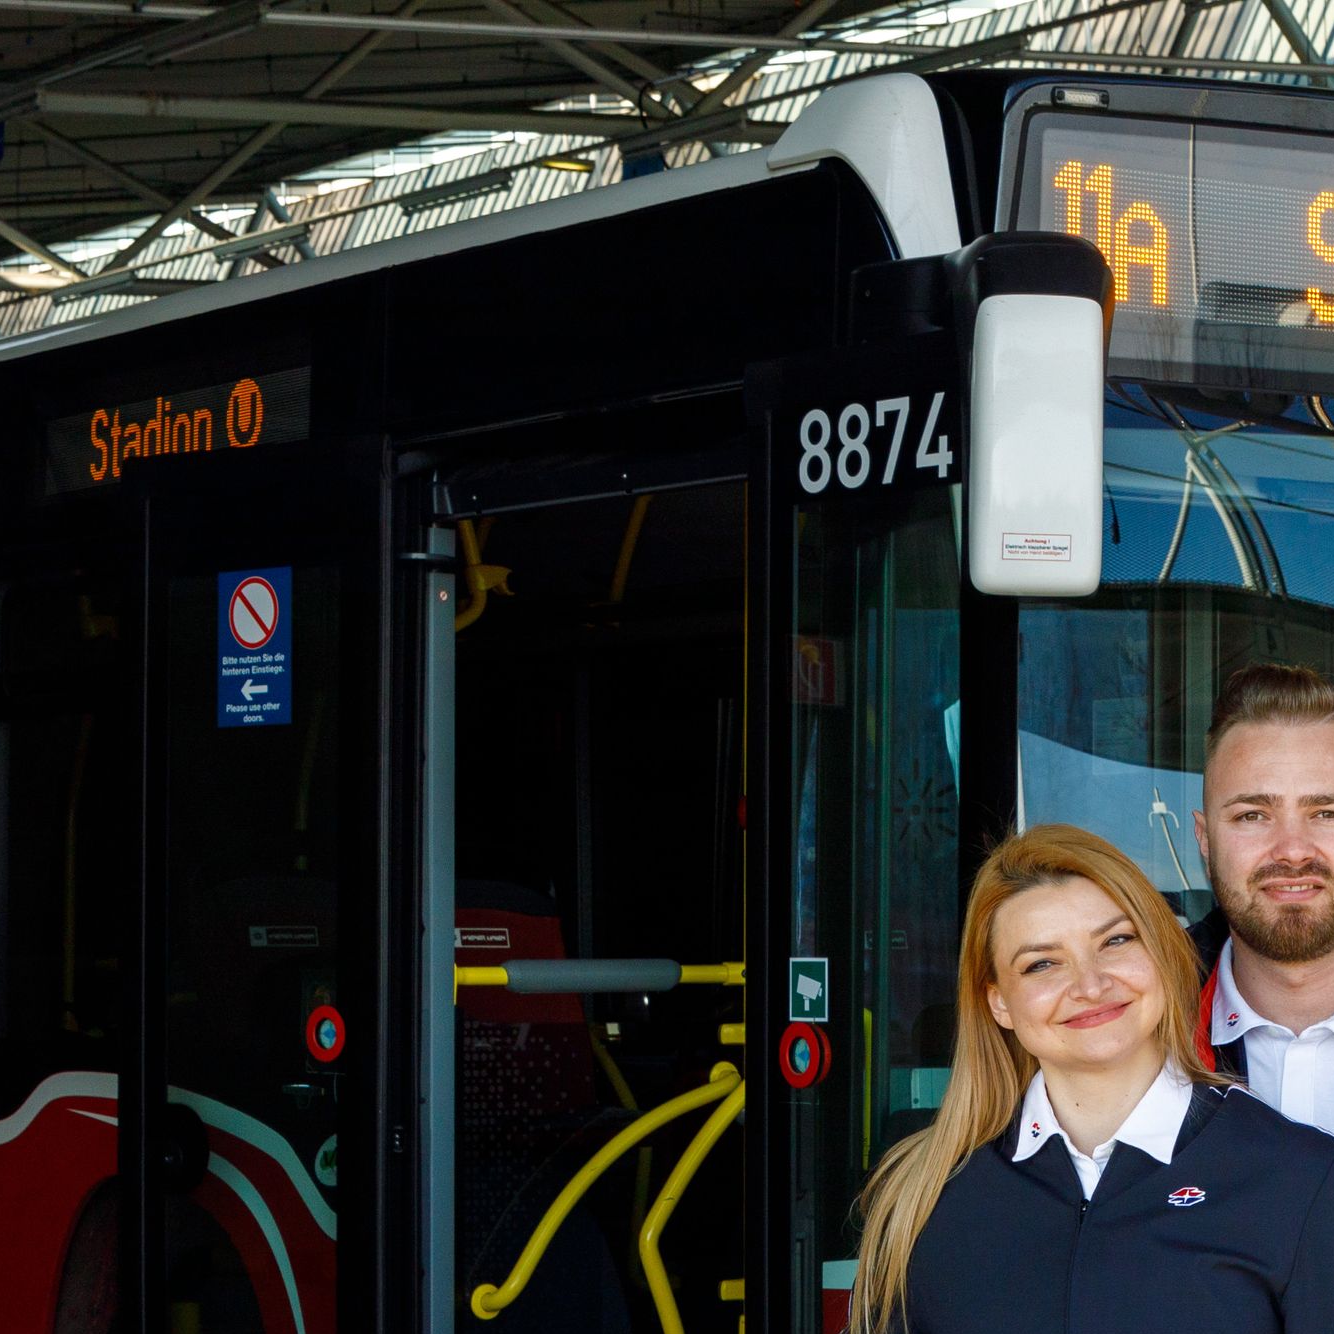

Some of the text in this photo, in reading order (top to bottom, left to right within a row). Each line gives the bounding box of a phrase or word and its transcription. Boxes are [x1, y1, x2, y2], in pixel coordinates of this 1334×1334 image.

[1053, 160, 1168, 306] 11A
[798, 391, 953, 494] 8874
[222, 652, 285, 666] Bitte nutzen Sie die
[222, 666, 250, 676] hinteren
[226, 701, 281, 713] Please use other
[243, 713, 265, 723] doors.
